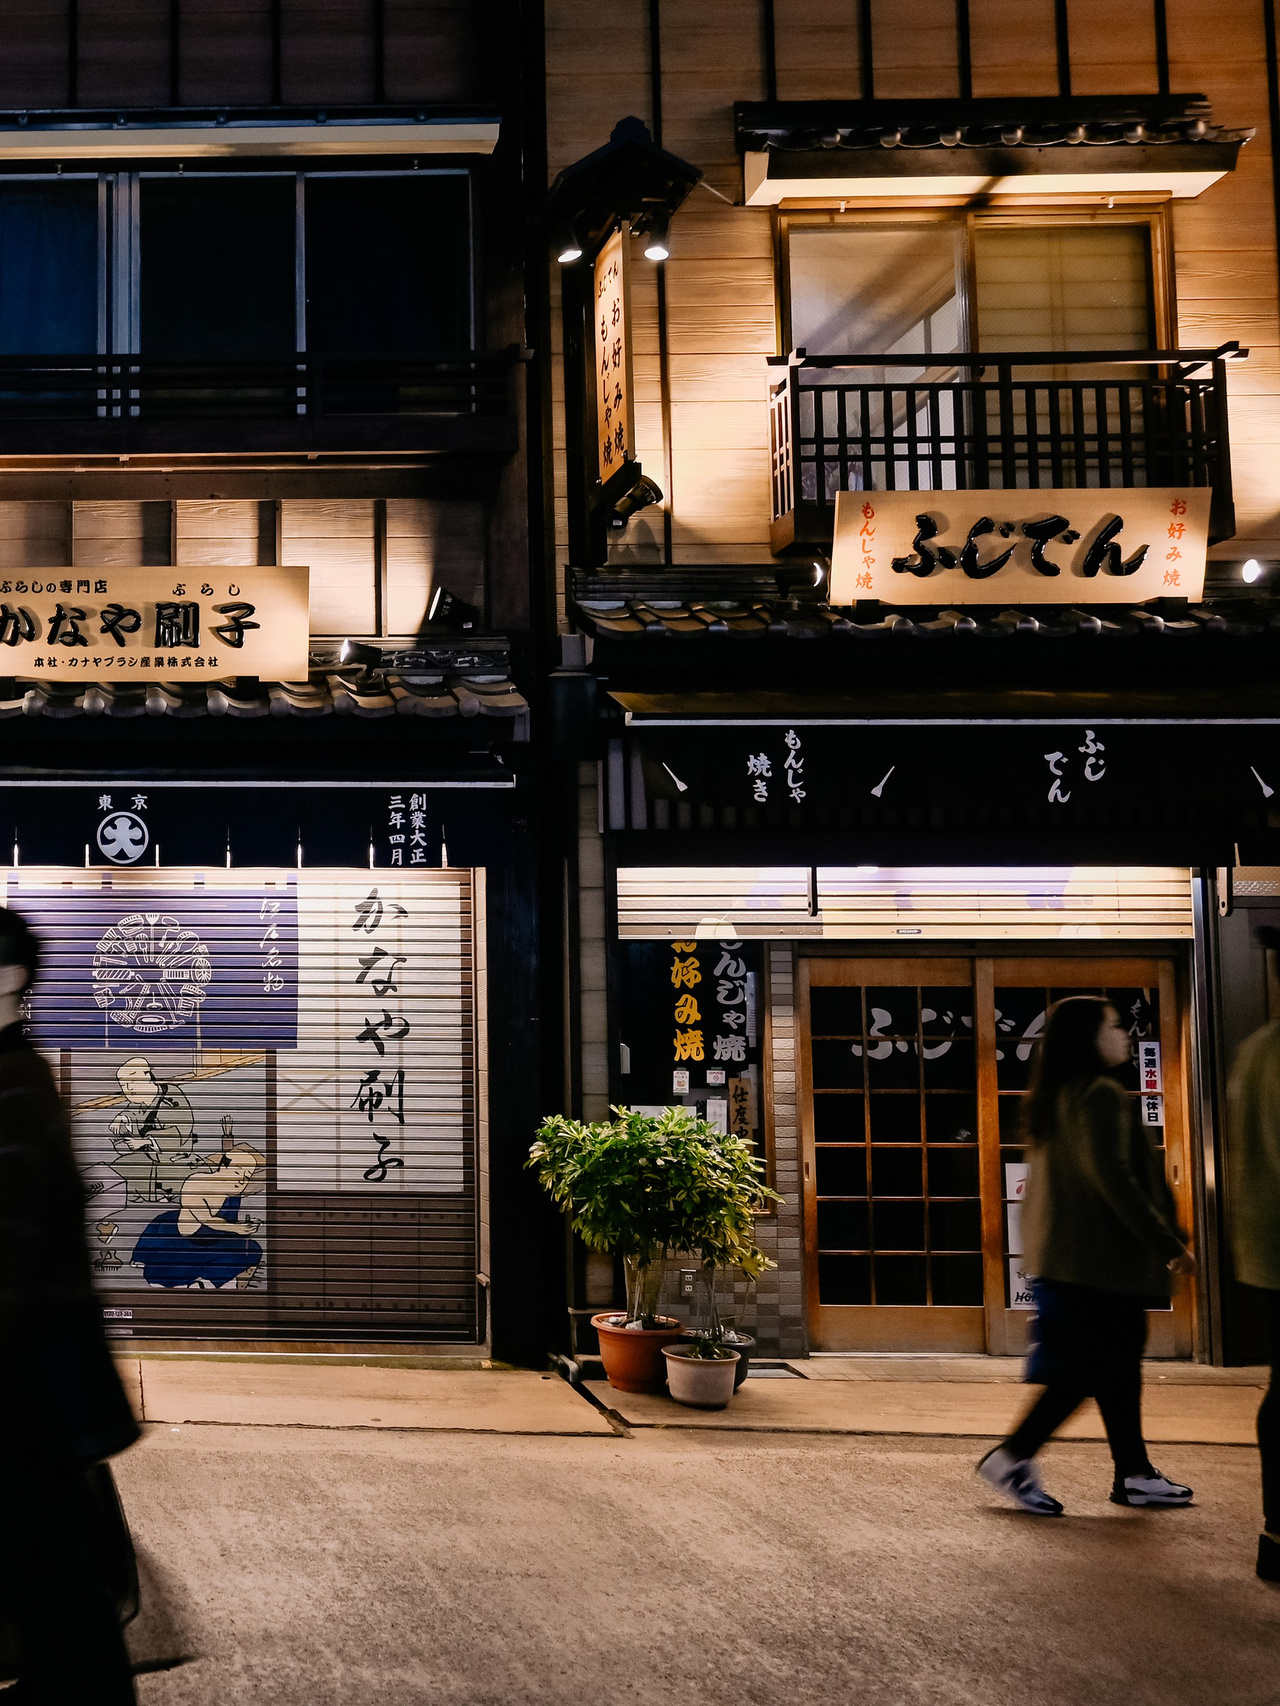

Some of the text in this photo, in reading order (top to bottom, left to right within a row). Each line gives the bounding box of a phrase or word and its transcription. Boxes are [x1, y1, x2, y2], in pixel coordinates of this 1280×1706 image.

[601, 315, 613, 466] もんじゃ焼
[612, 298, 625, 453] お好み焼
[855, 501, 877, 590] もんじゃ焼
[891, 514, 1150, 579] ふじでん
[1162, 499, 1187, 587] お好み焼
[747, 753, 772, 802] 焼き
[784, 729, 806, 804] もんじゃ
[1044, 751, 1071, 804] でん
[1078, 730, 1106, 782] ふじ
[97, 793, 148, 811] 東京
[388, 795, 406, 866] 三年四月
[408, 793, 427, 865] 創業大正
[350, 887, 410, 1183] かなや刷子
